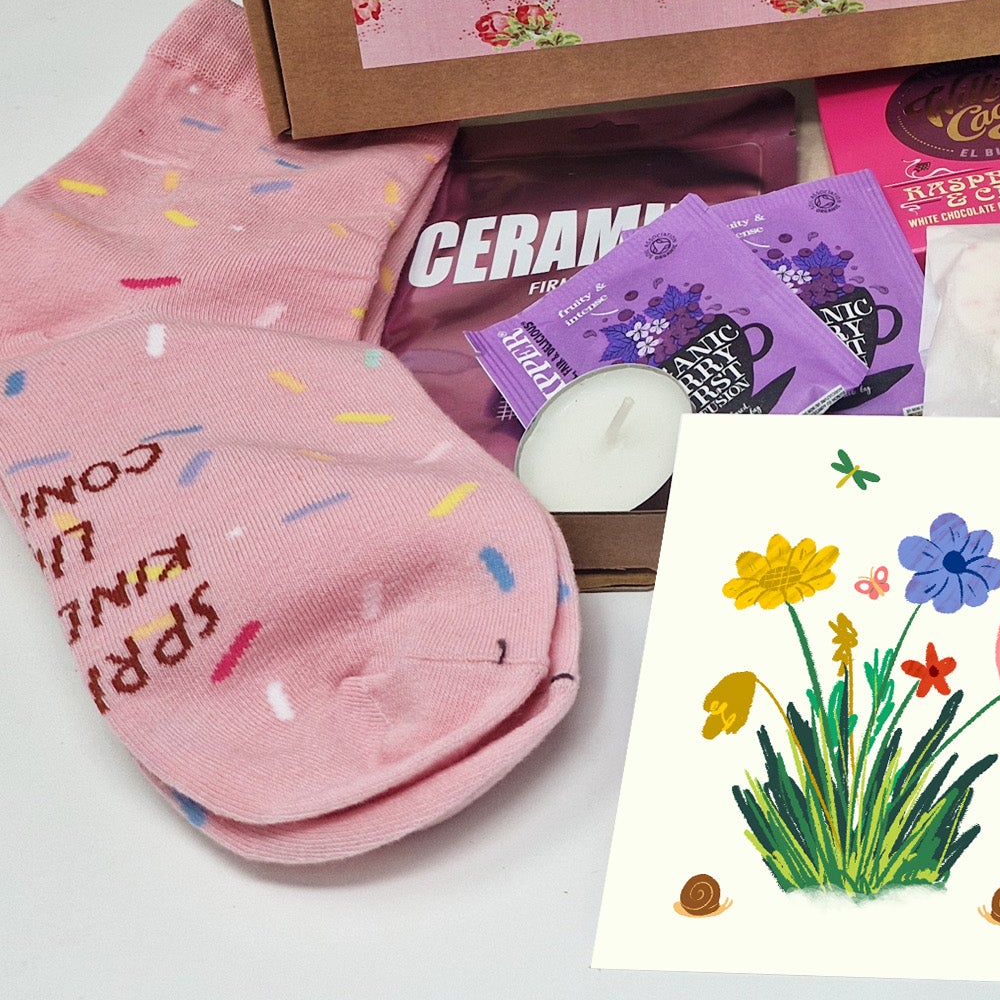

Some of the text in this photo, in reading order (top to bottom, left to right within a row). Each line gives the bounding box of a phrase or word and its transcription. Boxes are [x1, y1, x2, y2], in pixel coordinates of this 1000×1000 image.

[960, 148, 978, 158] EL
[908, 214, 940, 229] WHITE
[941, 203, 996, 222] CHOCOLATE
[947, 193, 968, 208] &
[727, 213, 766, 230] uity &
[735, 226, 764, 239] ense
[408, 203, 682, 288] CERAMI
[558, 282, 607, 319] fruity &
[565, 294, 608, 327] intense
[523, 321, 573, 377] FAIR & DELICIOUS
[663, 324, 740, 379] ANIC
[679, 343, 737, 396] RRY
[691, 361, 745, 408] RST
